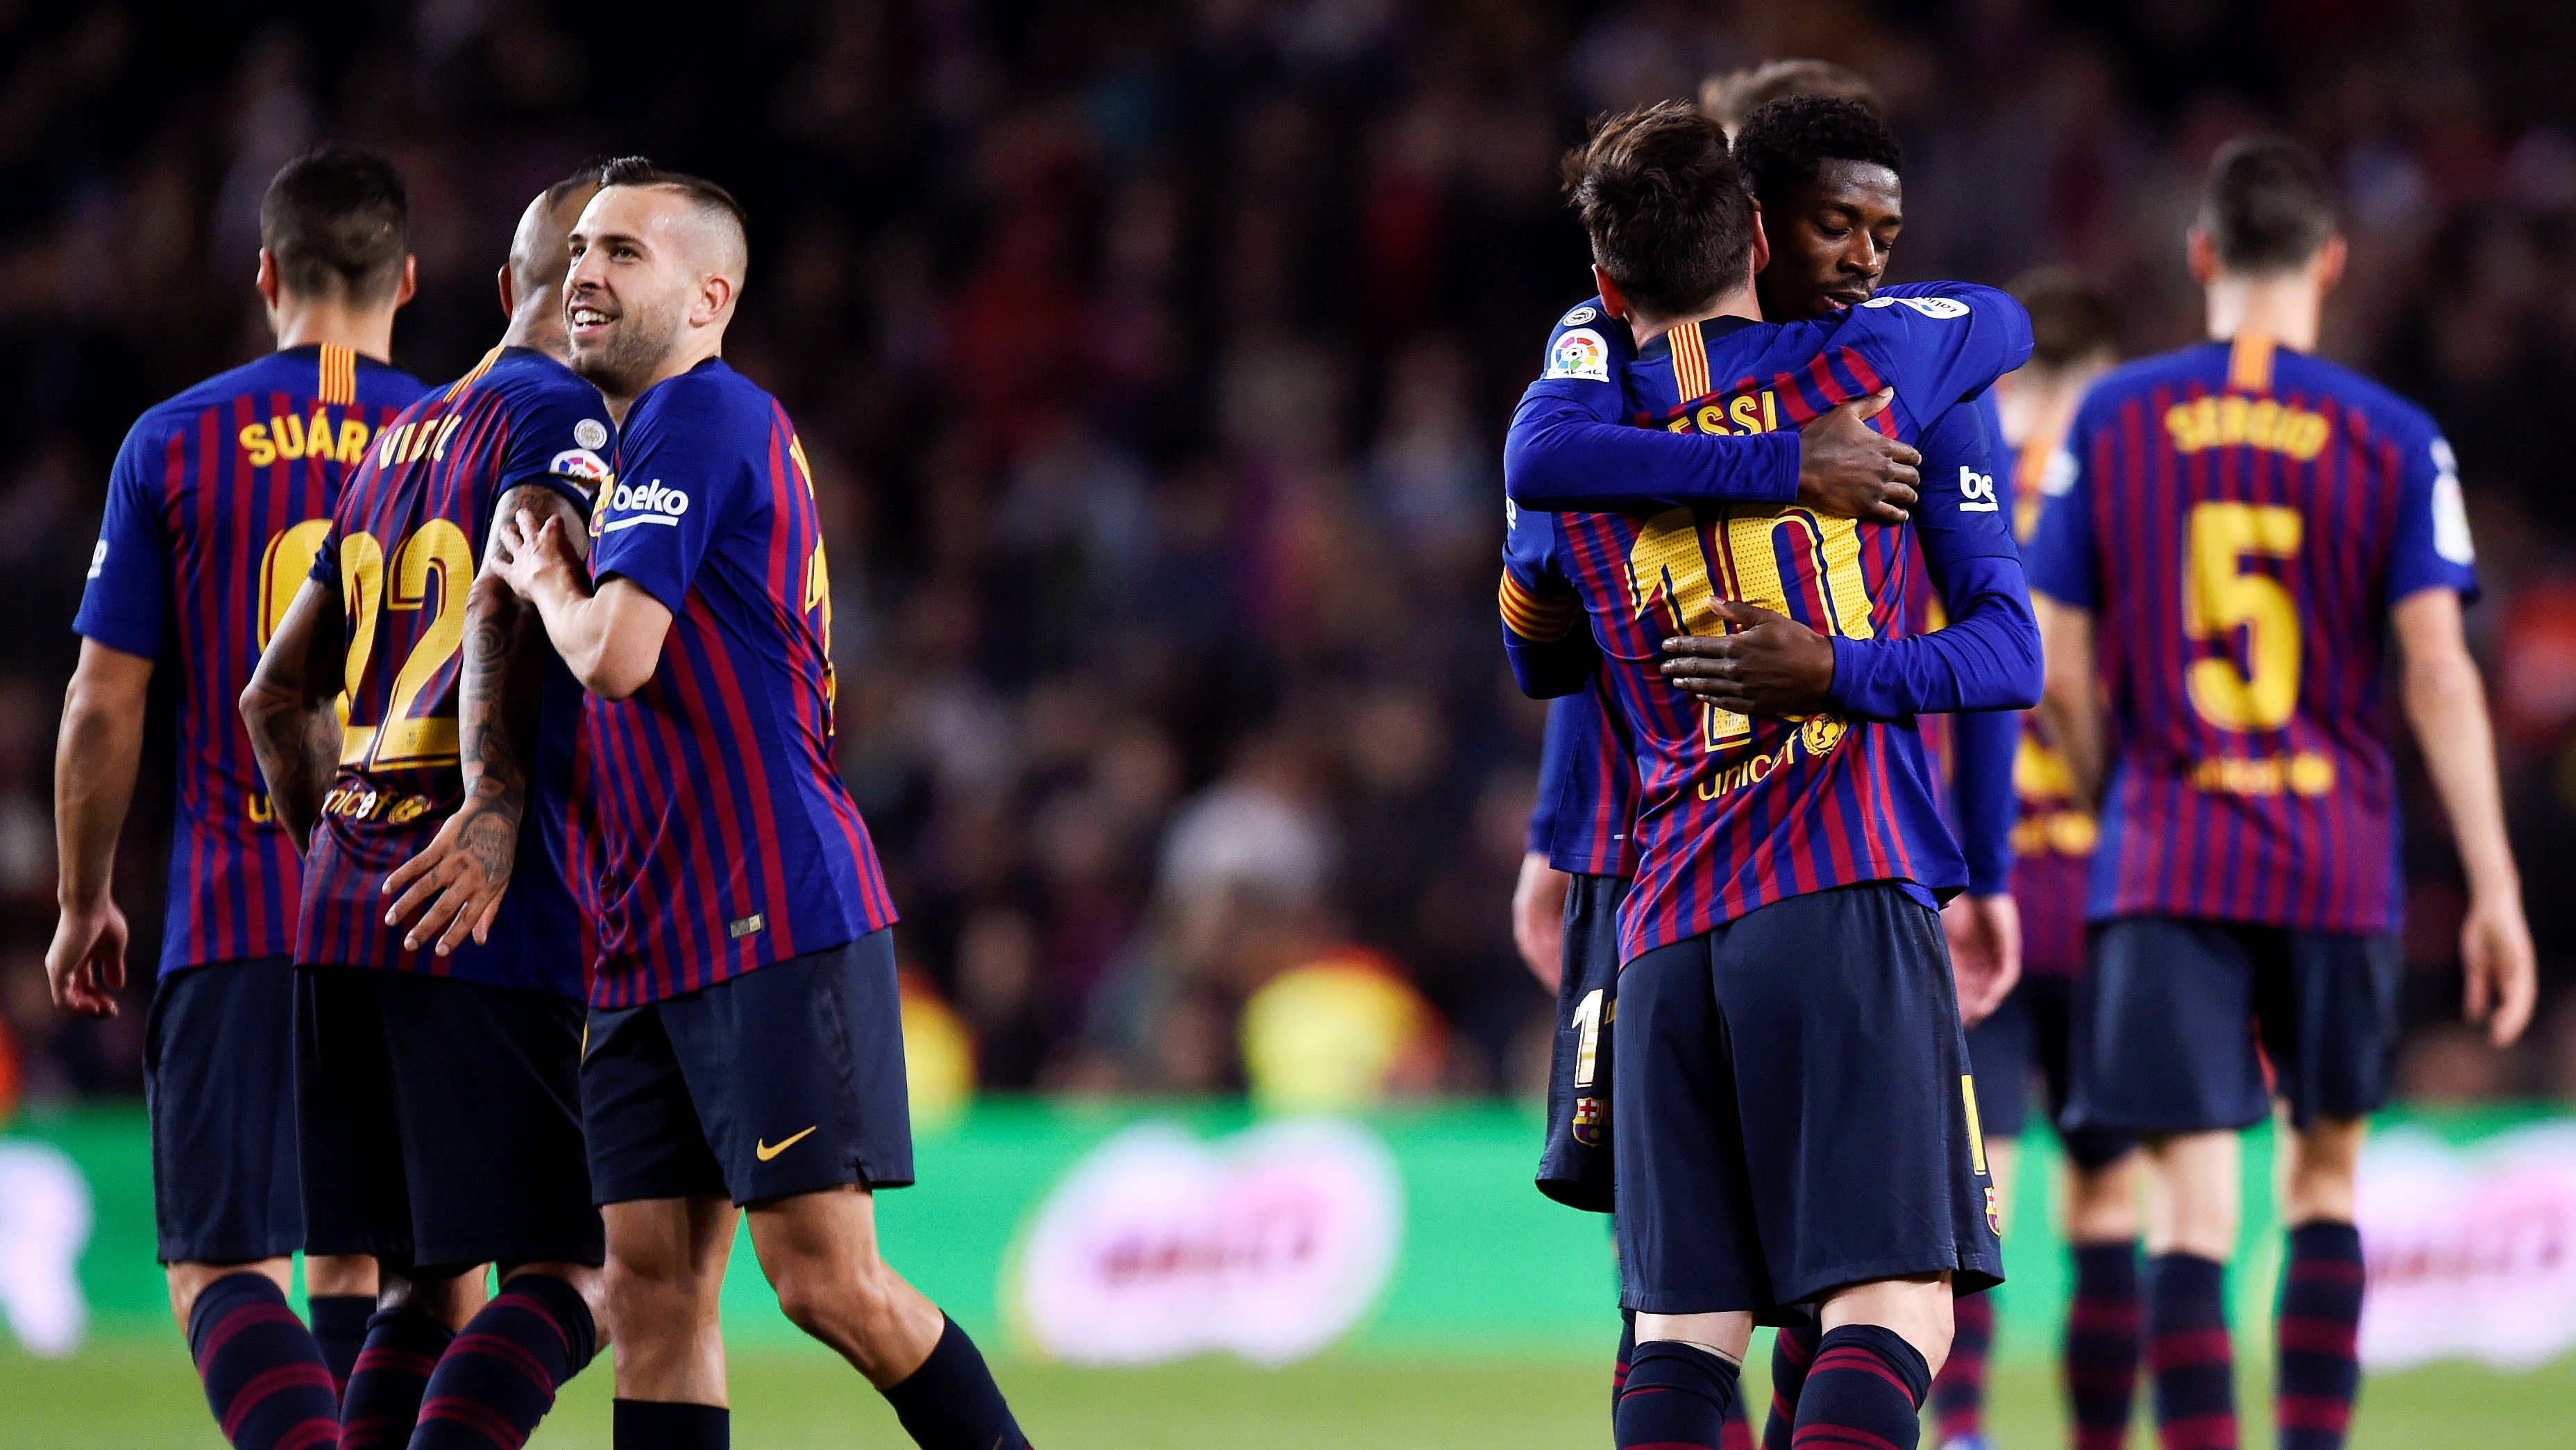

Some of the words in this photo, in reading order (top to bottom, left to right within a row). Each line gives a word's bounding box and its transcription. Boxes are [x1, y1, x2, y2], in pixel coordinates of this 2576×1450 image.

[239, 407, 389, 468] SUÁR
[613, 478, 689, 516] beko
[337, 518, 475, 773] 22
[2185, 500, 2303, 733] 5
[321, 782, 400, 822] nicef
